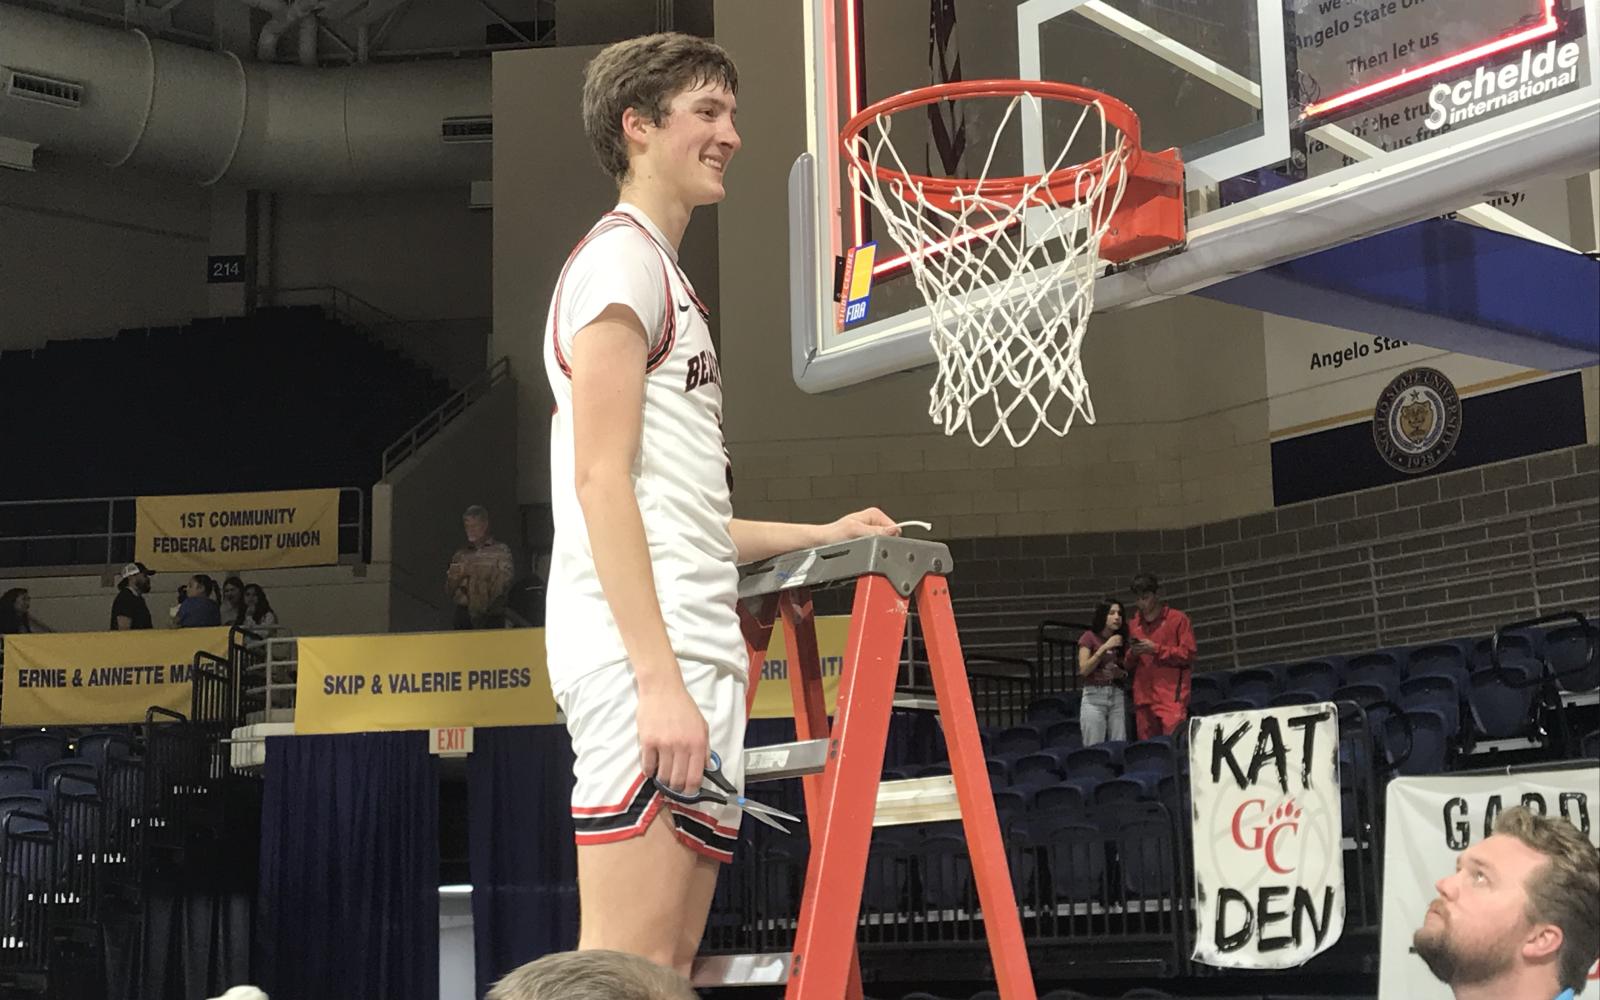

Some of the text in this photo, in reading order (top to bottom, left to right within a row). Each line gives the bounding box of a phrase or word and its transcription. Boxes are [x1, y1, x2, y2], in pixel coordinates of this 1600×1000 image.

[1353, 2, 1396, 28] State
[1347, 31, 1440, 75] Then let us
[1424, 40, 1580, 130] Schelde
[1449, 65, 1577, 125] international
[1403, 102, 1431, 121] tru
[213, 261, 241, 277] 214
[845, 301, 867, 323] FIBA
[1309, 336, 1409, 370] Angelo Sta
[179, 507, 297, 529] 1ST COMMUNITY
[153, 530, 321, 554] FEDERAL CREDIT UNION
[18, 668, 67, 688] ERNIE
[71, 667, 83, 687] &
[87, 665, 165, 687] ANNETTE
[323, 667, 532, 696] SKIP & VALERIE PRIESS
[437, 728, 467, 751] EXIT
[1211, 711, 1331, 795] KAT
[1214, 885, 1335, 953] DEN
